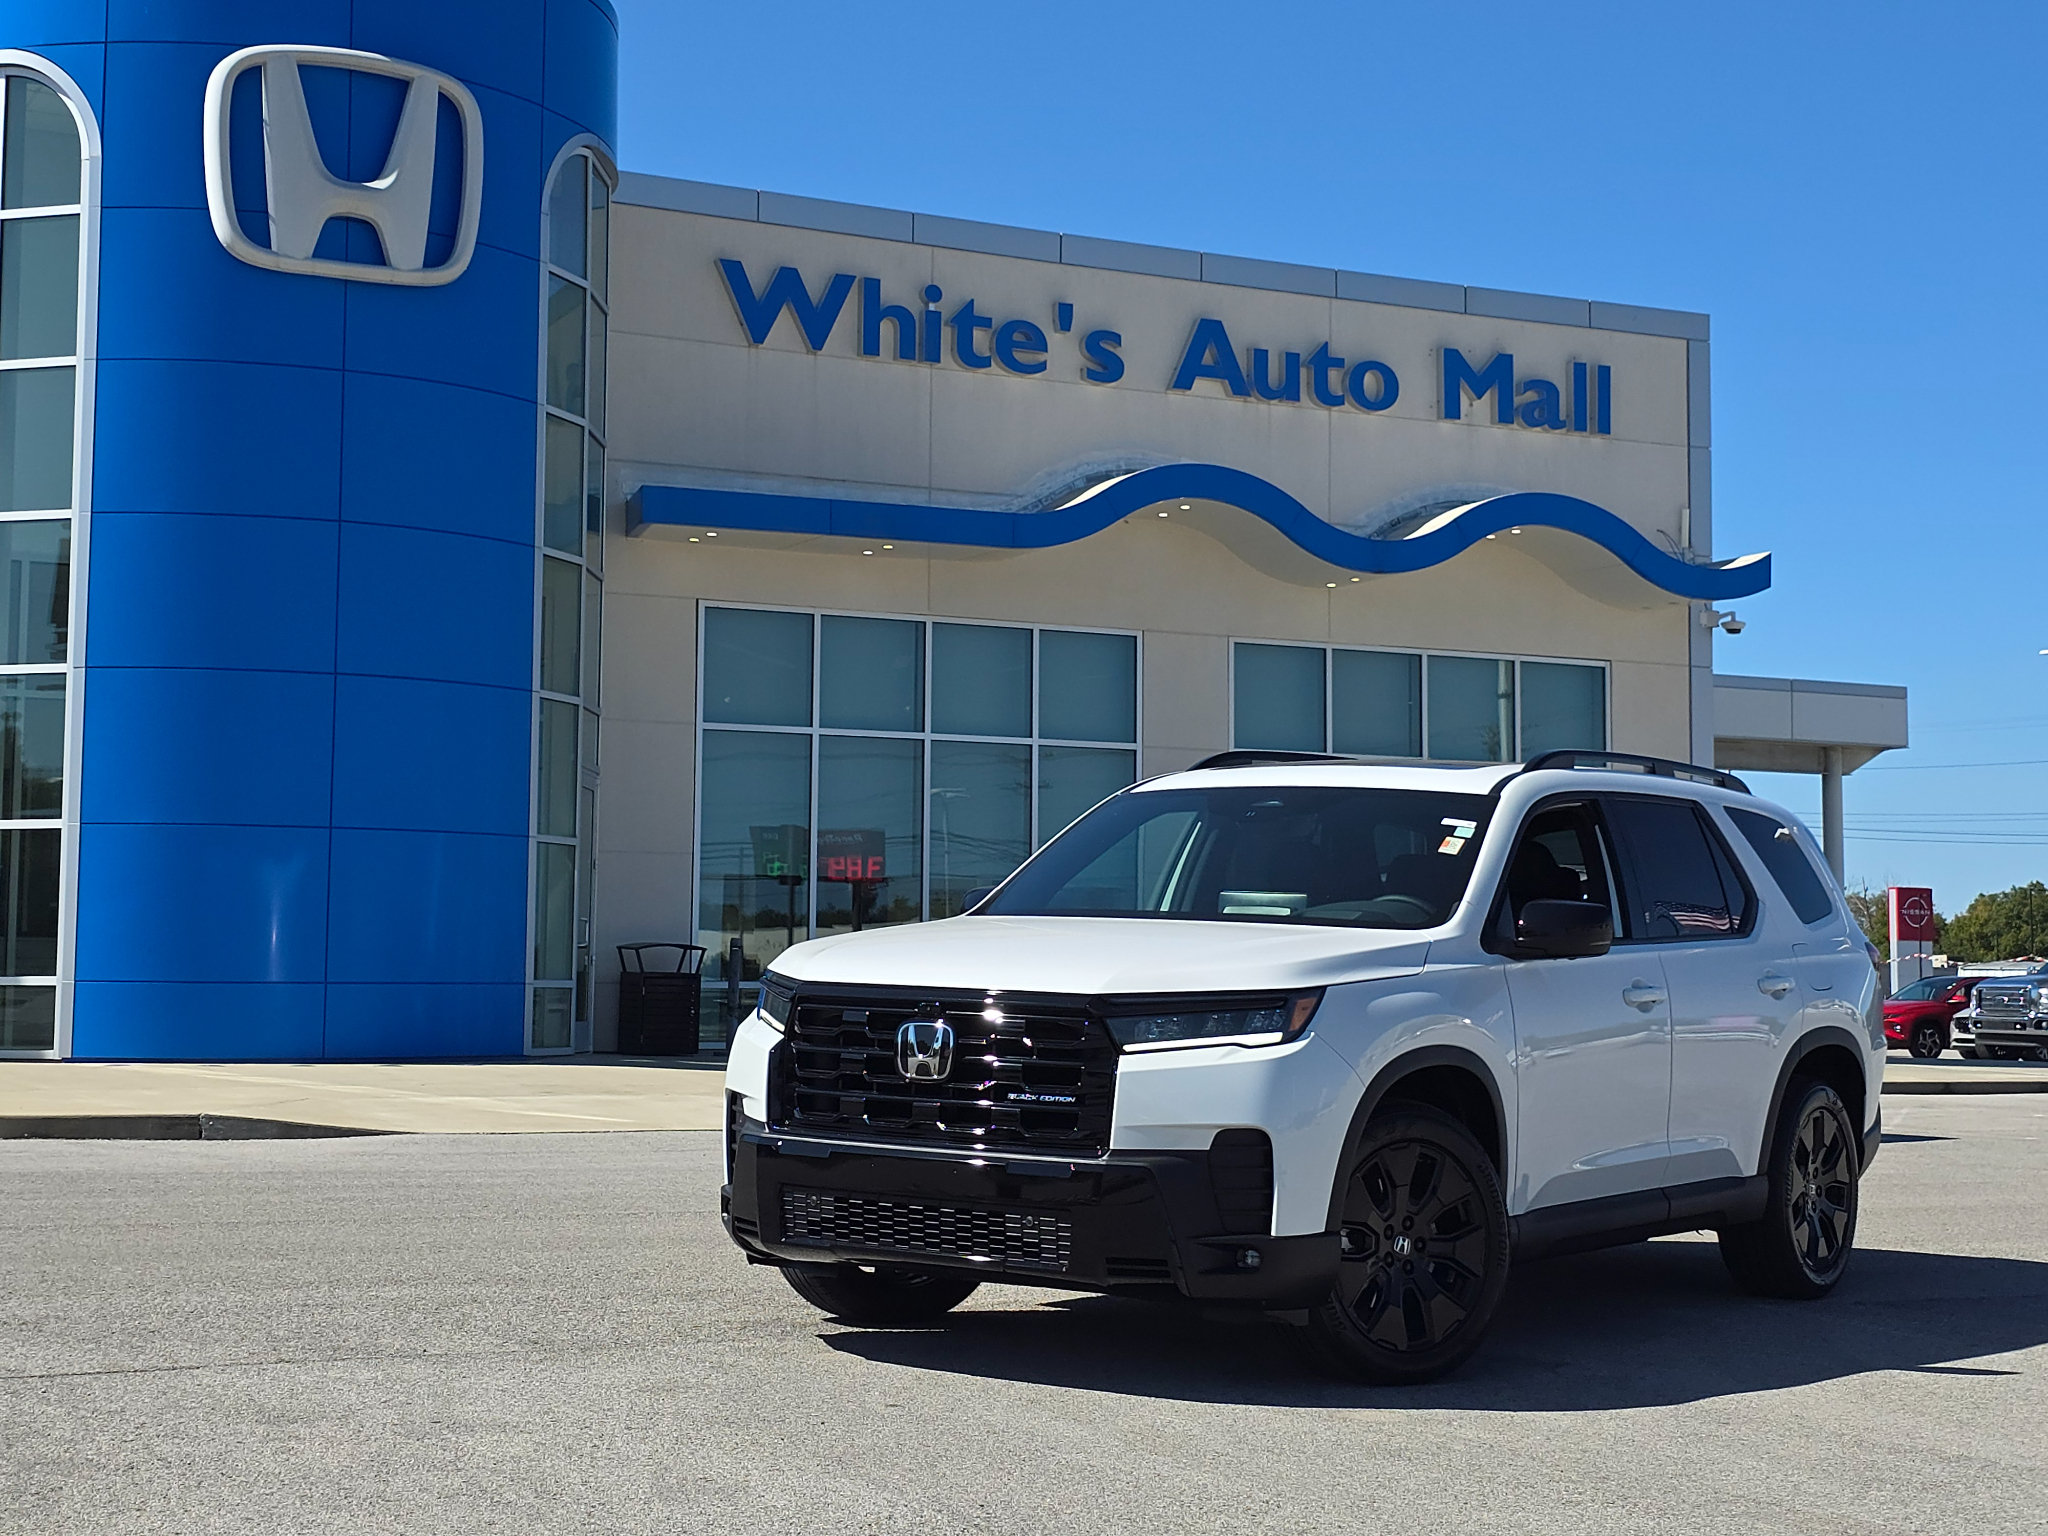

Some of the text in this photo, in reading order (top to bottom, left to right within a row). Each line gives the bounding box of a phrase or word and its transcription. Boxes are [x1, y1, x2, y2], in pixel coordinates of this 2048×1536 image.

[715, 257, 1612, 436] White's Auto Mall
[1006, 1092, 1077, 1103] BLACK EDITION
